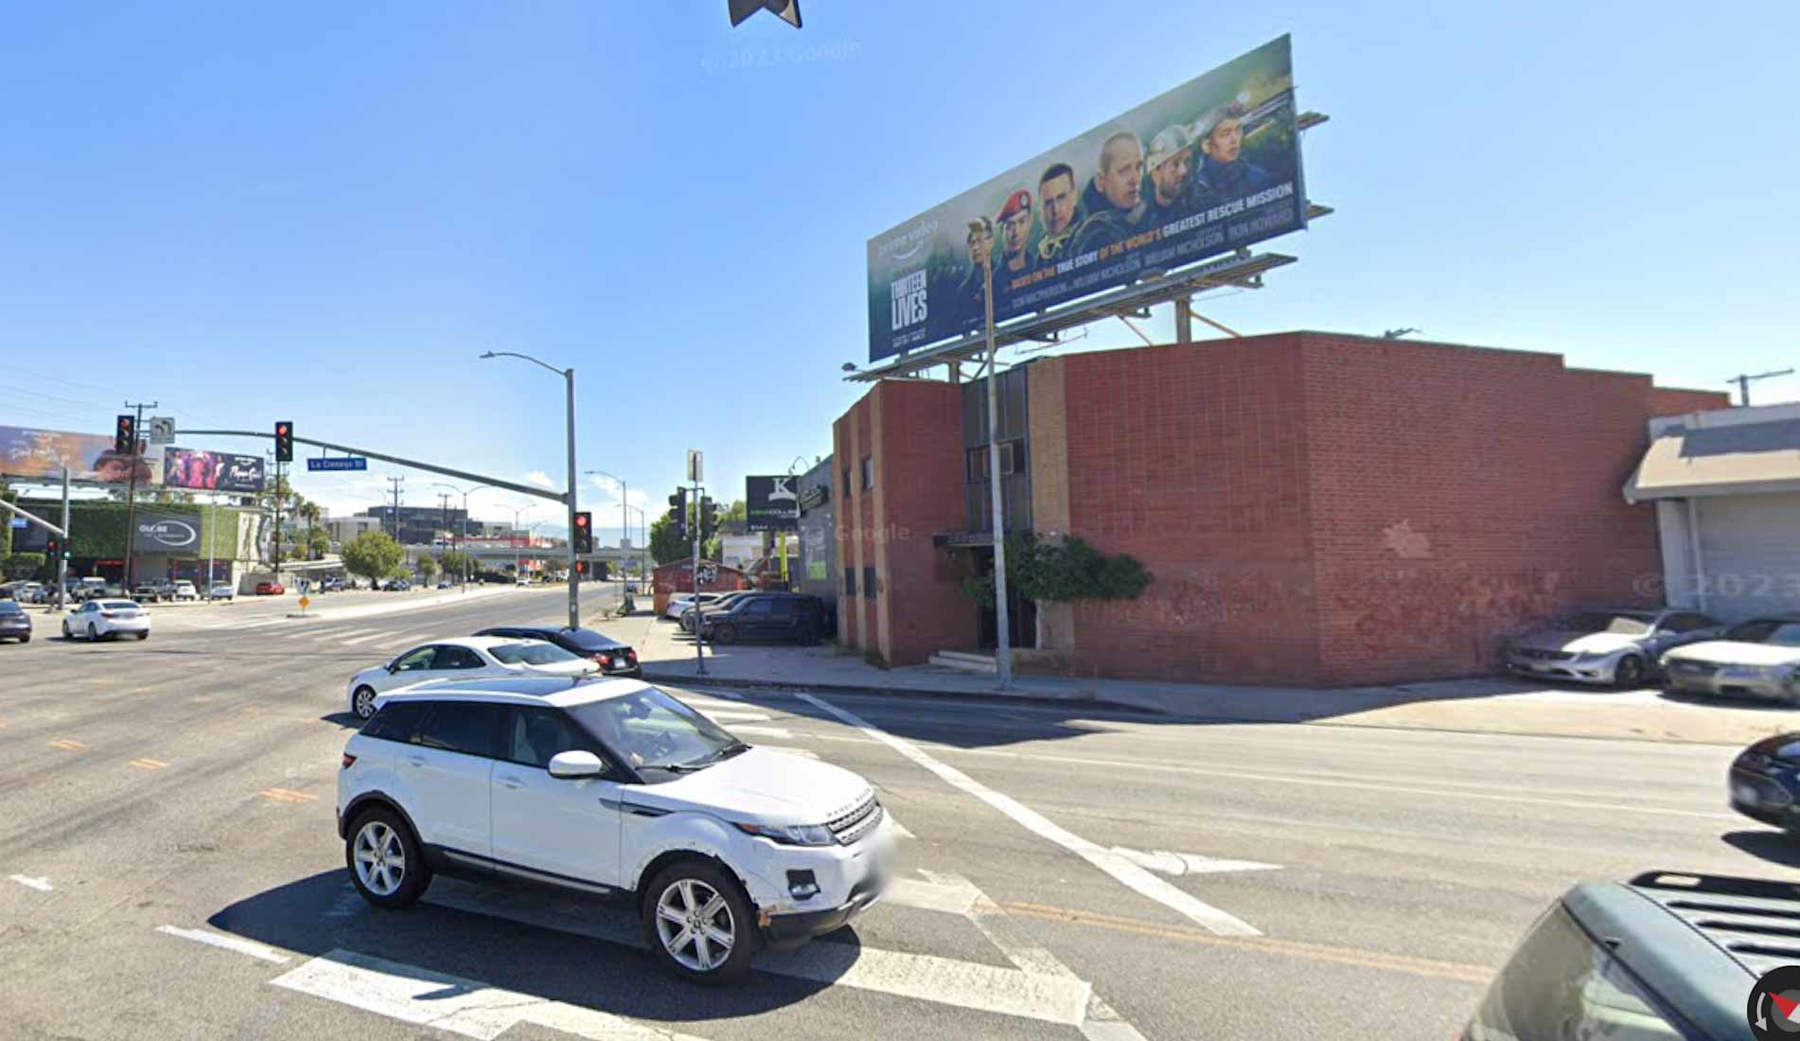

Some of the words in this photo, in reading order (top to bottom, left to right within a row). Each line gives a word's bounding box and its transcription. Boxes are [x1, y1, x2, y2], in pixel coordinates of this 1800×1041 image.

[1057, 259, 1074, 274] TRUE
[1075, 250, 1098, 268] STORY
[1100, 248, 1110, 259] OF
[1110, 242, 1125, 255] THE
[1163, 212, 1206, 238] GREATEST
[1207, 199, 1245, 222] RESCUE
[1246, 181, 1294, 209] MISSION
[892, 289, 928, 331] LIVES
[310, 460, 321, 469] La
